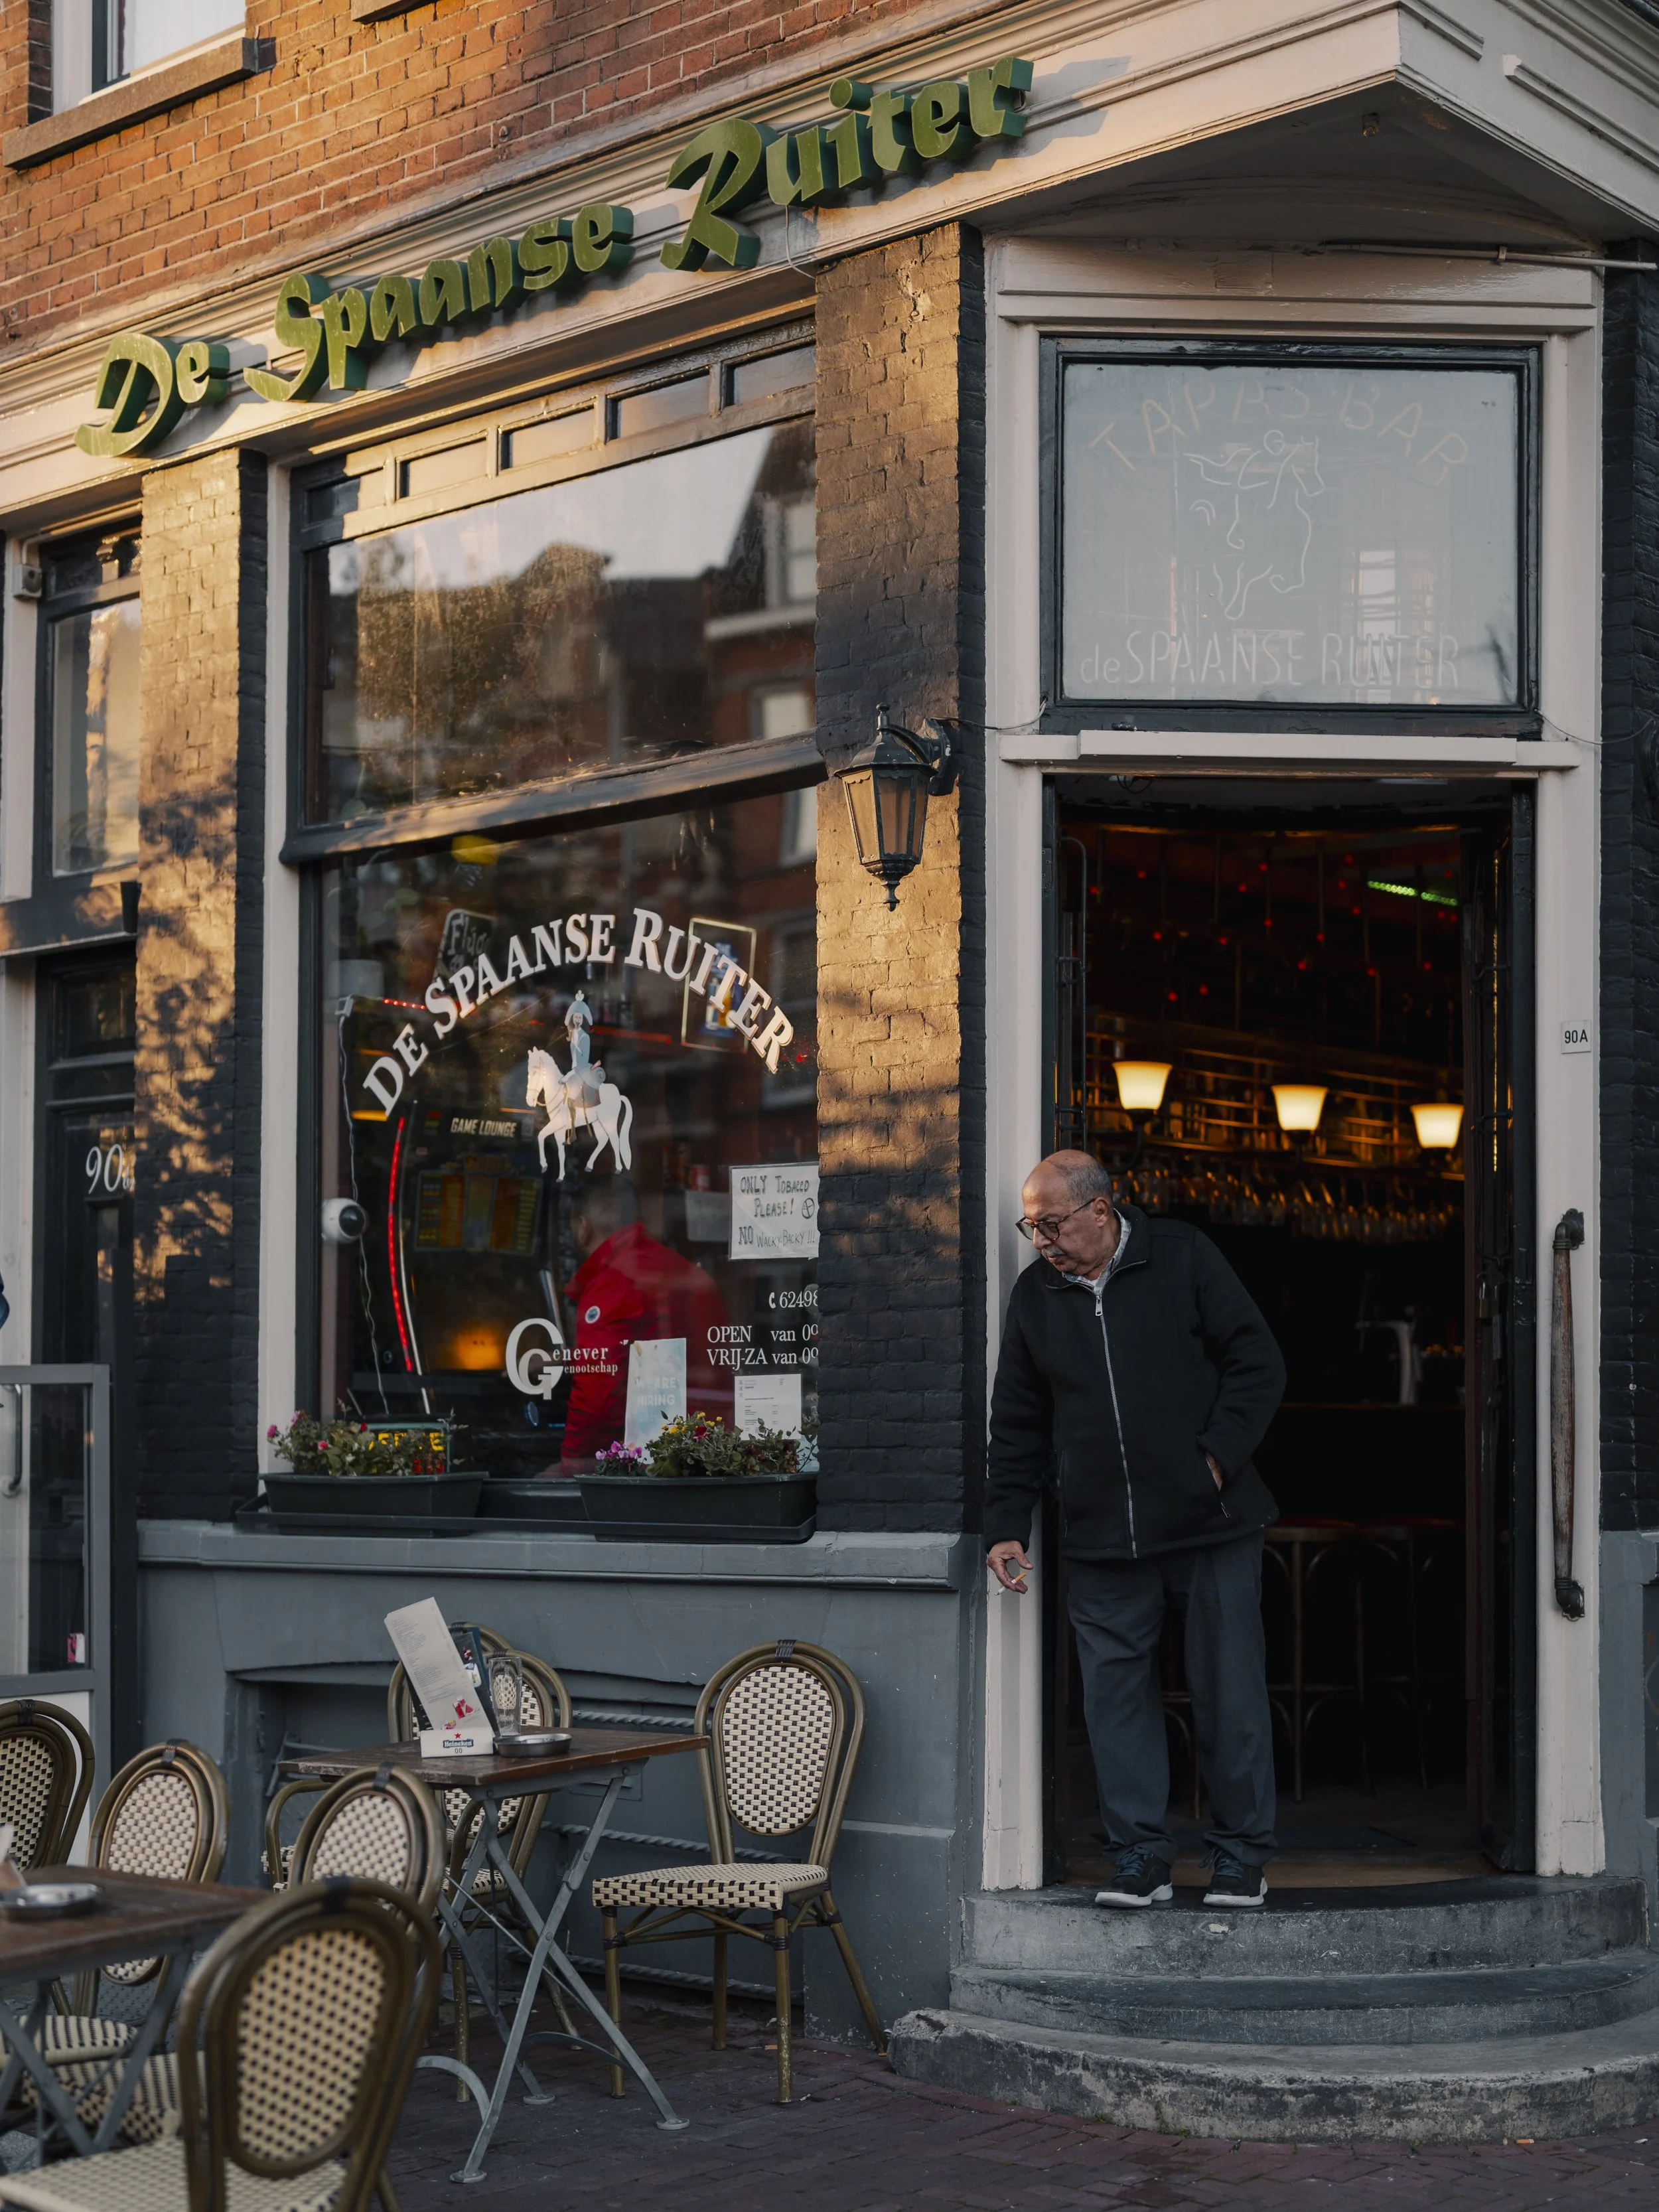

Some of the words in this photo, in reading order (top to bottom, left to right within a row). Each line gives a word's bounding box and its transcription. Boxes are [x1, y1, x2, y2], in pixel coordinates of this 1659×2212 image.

[74, 332, 230, 458] De
[243, 203, 634, 402] Spaanse
[660, 55, 1038, 271] Ruiter
[1080, 642, 1121, 684] de
[1127, 629, 1305, 688] SPAANSE
[1321, 630, 1460, 688] RUITER
[362, 1023, 429, 1118] DE
[424, 913, 616, 1041] SPAANSE
[624, 907, 794, 1074] RUITER
[1564, 1029, 1588, 1044] 90A
[450, 1117, 478, 1135] GAME
[479, 1120, 518, 1138] LOUNGE
[740, 1175, 767, 1194] ONLY
[738, 1225, 754, 1246] NO
[707, 1325, 752, 1343] OPEN
[770, 1329, 796, 1341] van
[706, 1348, 768, 1371] VRIJ-ZA
[772, 1352, 798, 1364] van
[654, 1376, 677, 1389] ARE
[637, 1394, 676, 1406] HIRING
